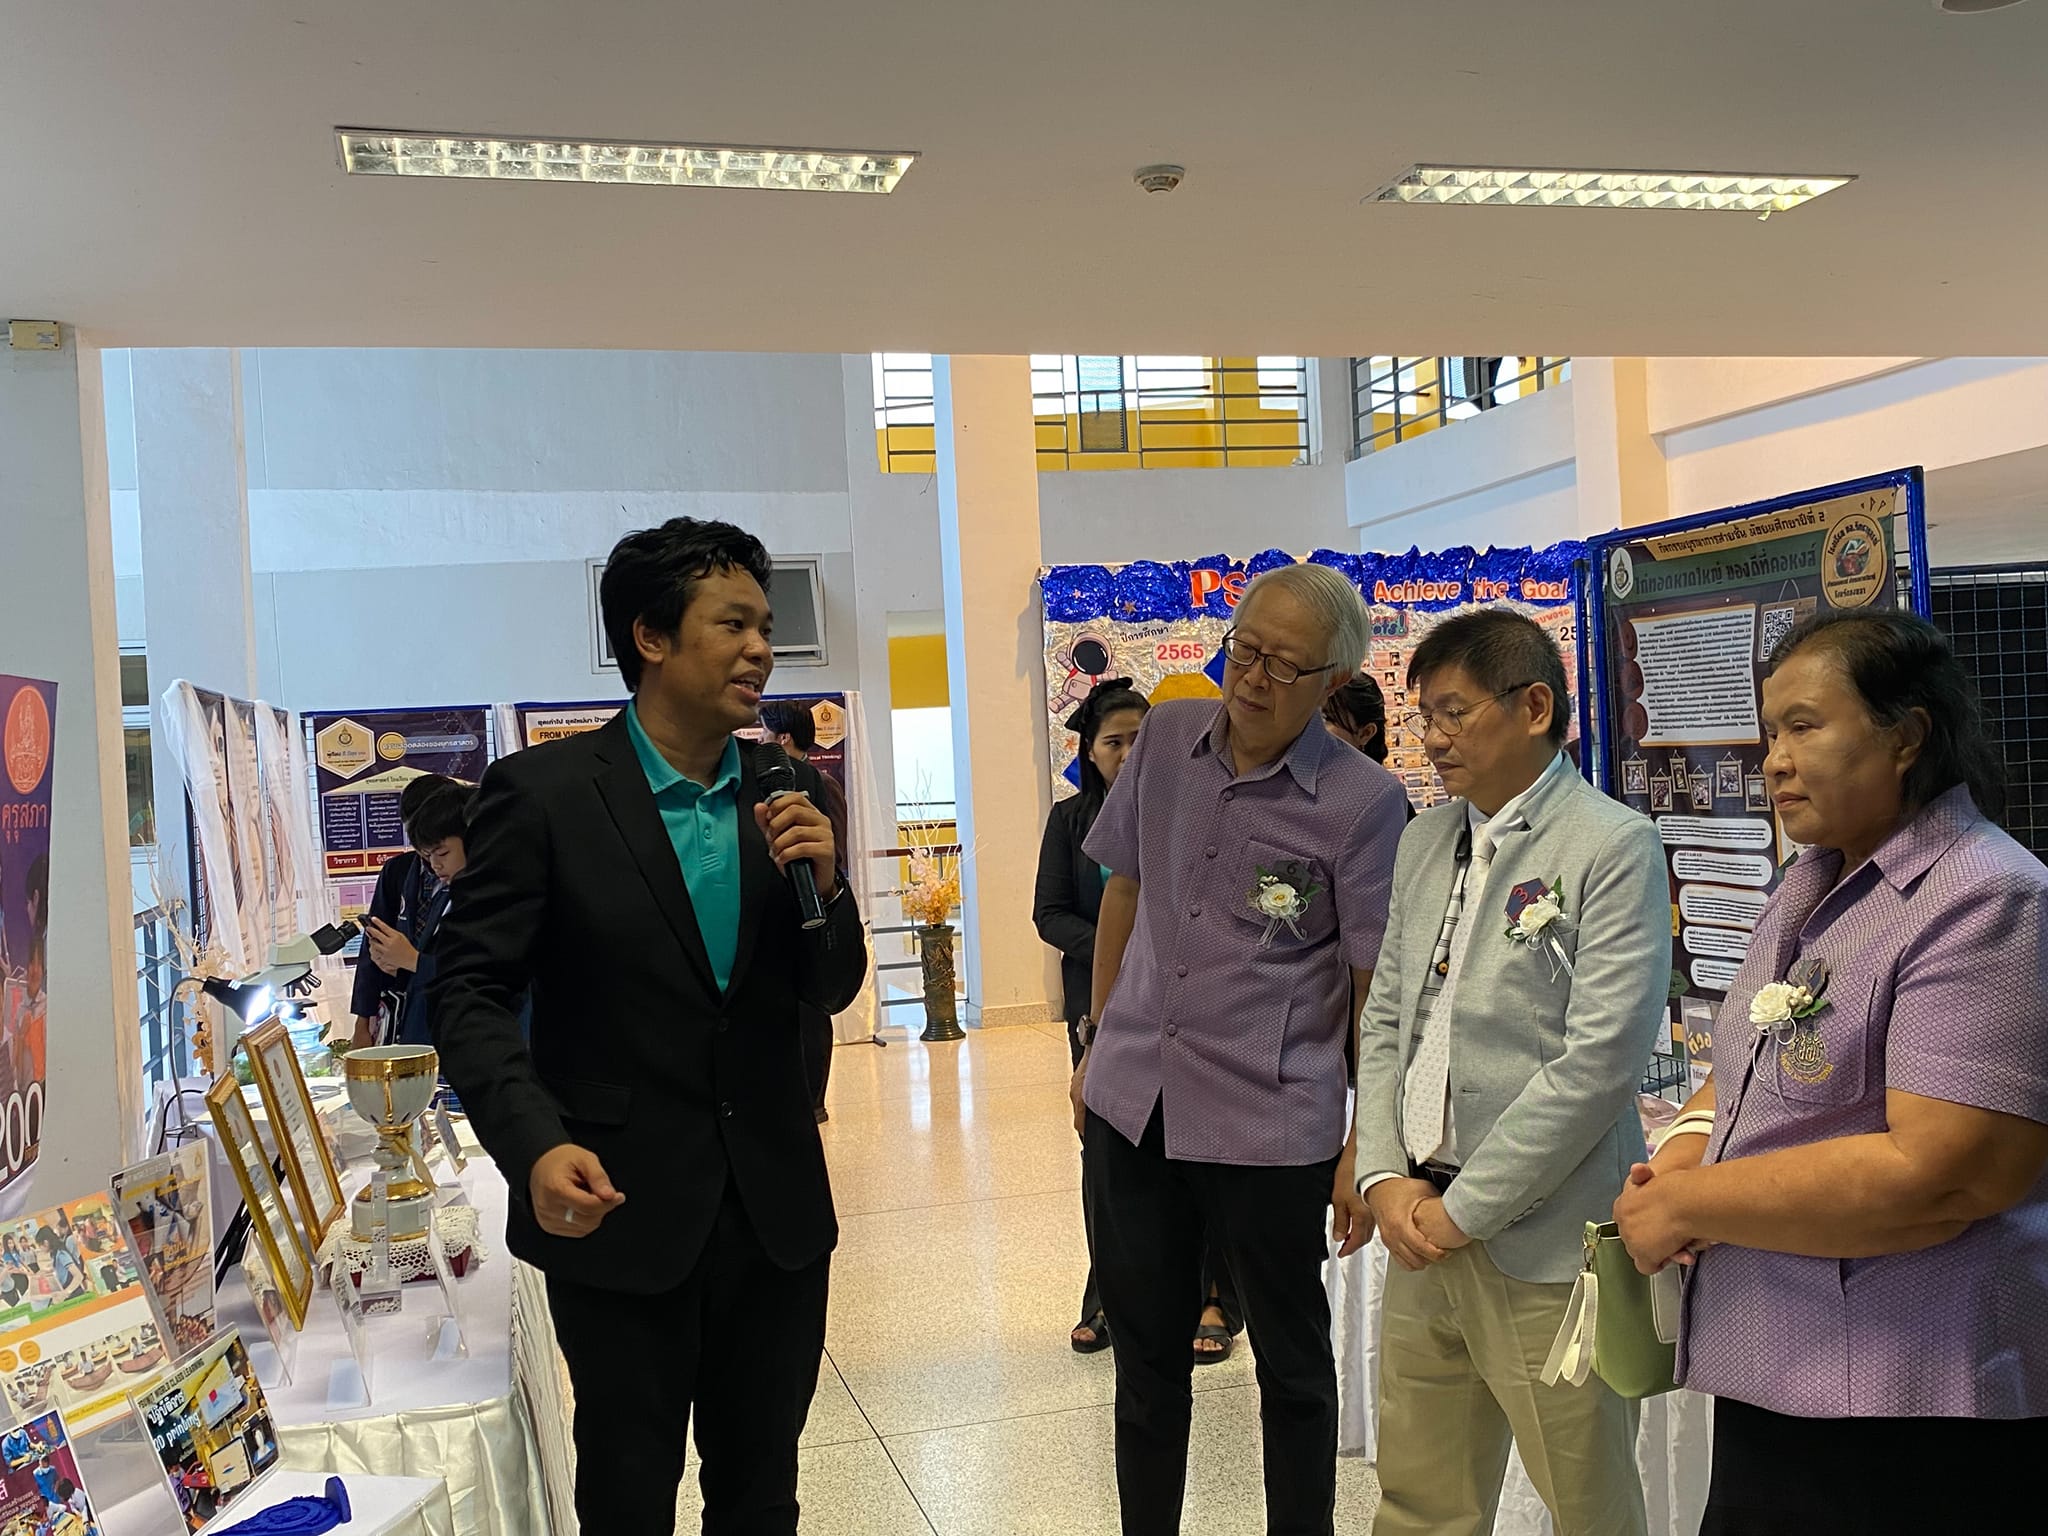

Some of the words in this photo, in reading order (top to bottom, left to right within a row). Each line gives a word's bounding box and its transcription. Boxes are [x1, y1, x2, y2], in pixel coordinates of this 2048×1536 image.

[1635, 561, 1723, 595] ไก่ทอดหาดใหญ่
[1726, 543, 1817, 581] ของดีที่คอหงส์
[1189, 569, 1262, 608] PS
[1374, 579, 1461, 602] Achieve
[1473, 577, 1509, 601] the
[1521, 577, 1569, 600] Goal
[1120, 624, 1170, 643] ปีการศึกษา
[1156, 643, 1205, 661] 2565
[539, 731, 561, 739] FROM
[2, 801, 47, 844] คุรุสภา
[333, 857, 358, 865] วิชาการ
[166, 1411, 201, 1448] printing
